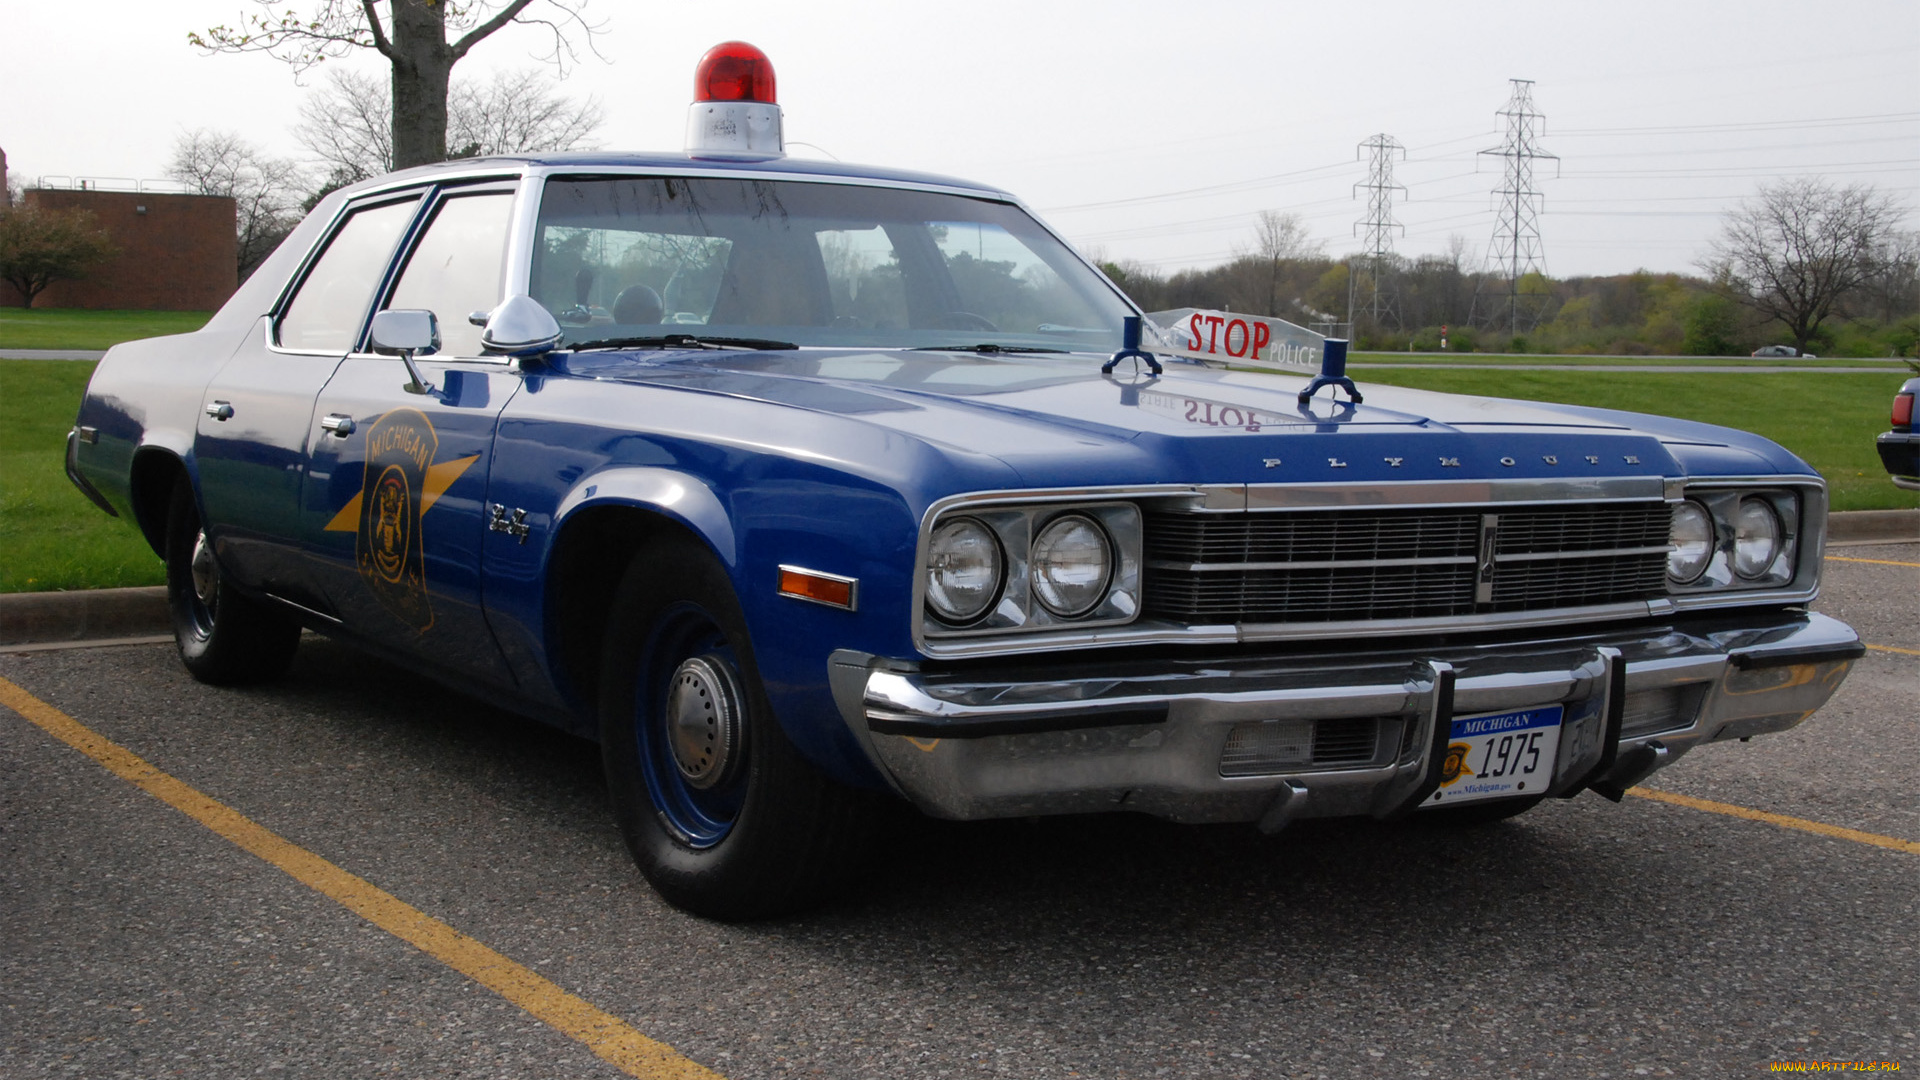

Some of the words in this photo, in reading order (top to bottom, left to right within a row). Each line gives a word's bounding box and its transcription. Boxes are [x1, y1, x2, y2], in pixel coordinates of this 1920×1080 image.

[1188, 313, 1270, 360] STOP
[1270, 342, 1316, 368] POLICE
[371, 425, 429, 472] MICHIGAN
[1263, 455, 1640, 468] PLYMOUTH
[1463, 714, 1530, 734] MICHIGAN
[1476, 732, 1543, 779] 1975
